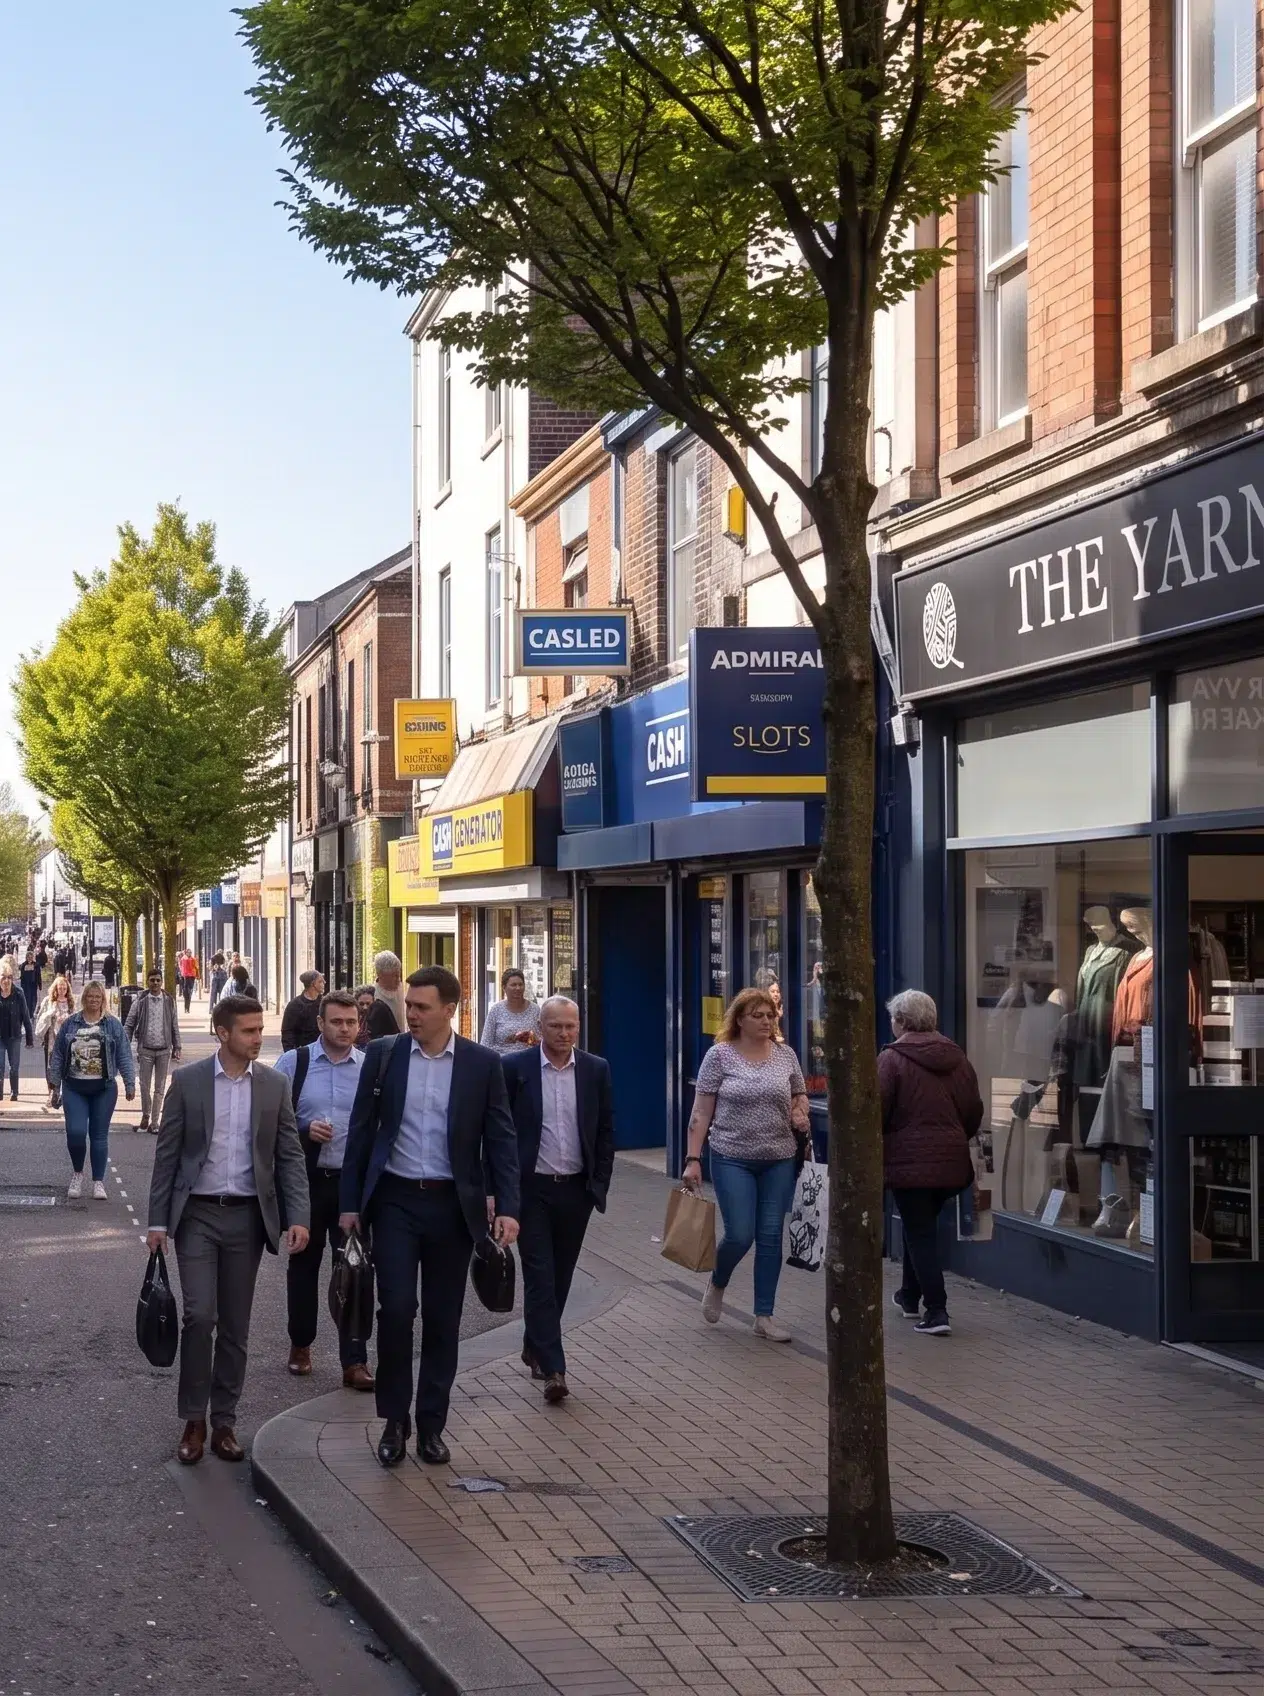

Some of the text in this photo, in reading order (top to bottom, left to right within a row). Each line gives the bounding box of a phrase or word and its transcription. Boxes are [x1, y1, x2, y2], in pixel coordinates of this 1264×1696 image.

[1009, 535, 1108, 635] THE
[528, 628, 621, 649] CASLED
[647, 725, 685, 772] CASH
[733, 725, 811, 747] SLOTS
[455, 809, 503, 848] GENERATOR
